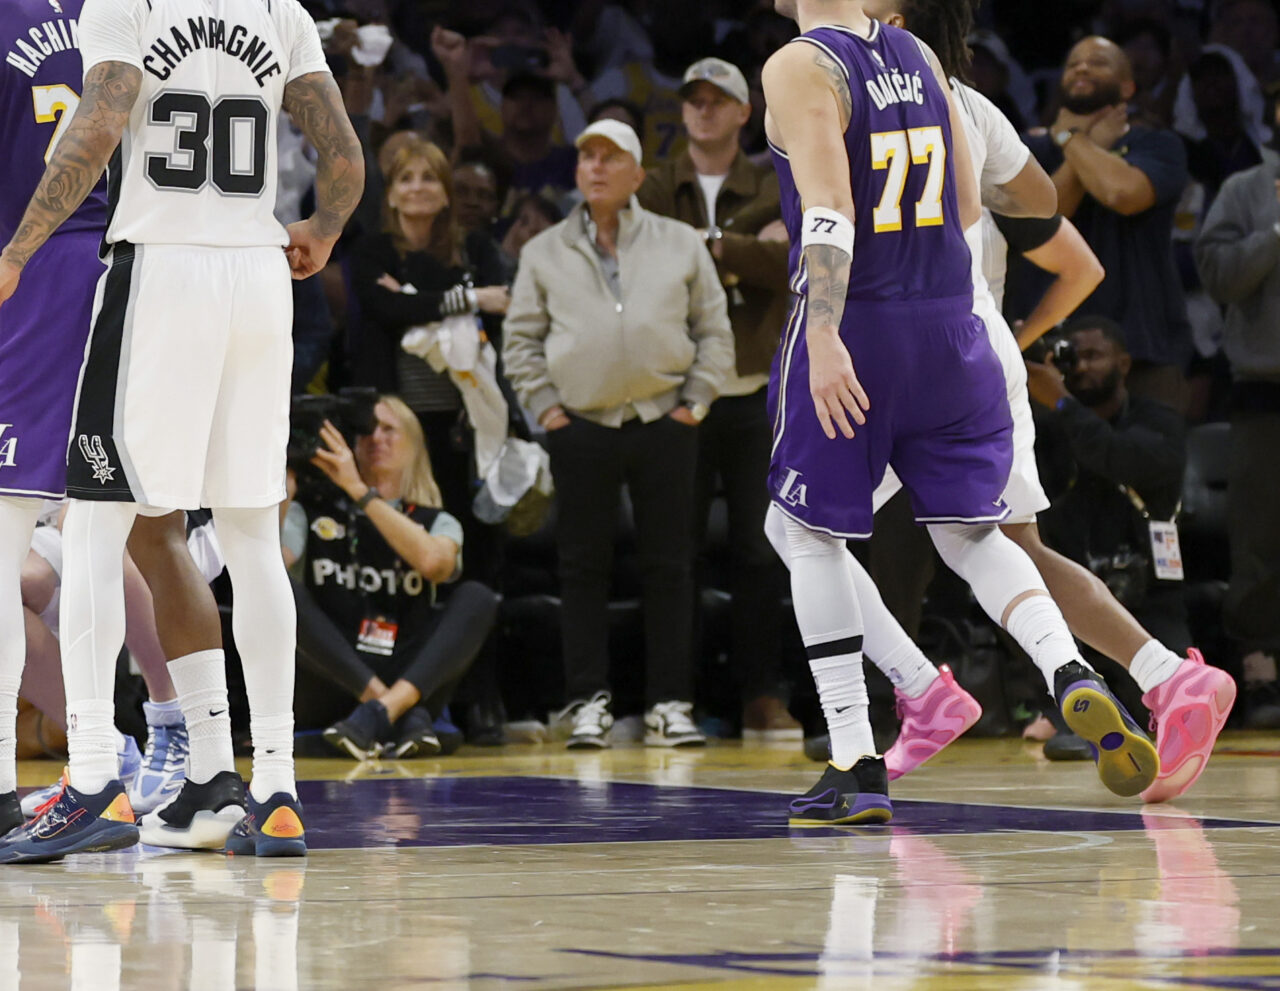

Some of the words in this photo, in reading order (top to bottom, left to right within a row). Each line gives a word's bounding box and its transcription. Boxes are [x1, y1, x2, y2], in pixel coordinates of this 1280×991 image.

[143, 16, 281, 88] CHAMPAGNIE
[143, 88, 270, 199] 30
[870, 125, 946, 234] 77
[810, 217, 837, 234] 77
[777, 466, 808, 508] LA
[313, 558, 422, 596] PHOTO
